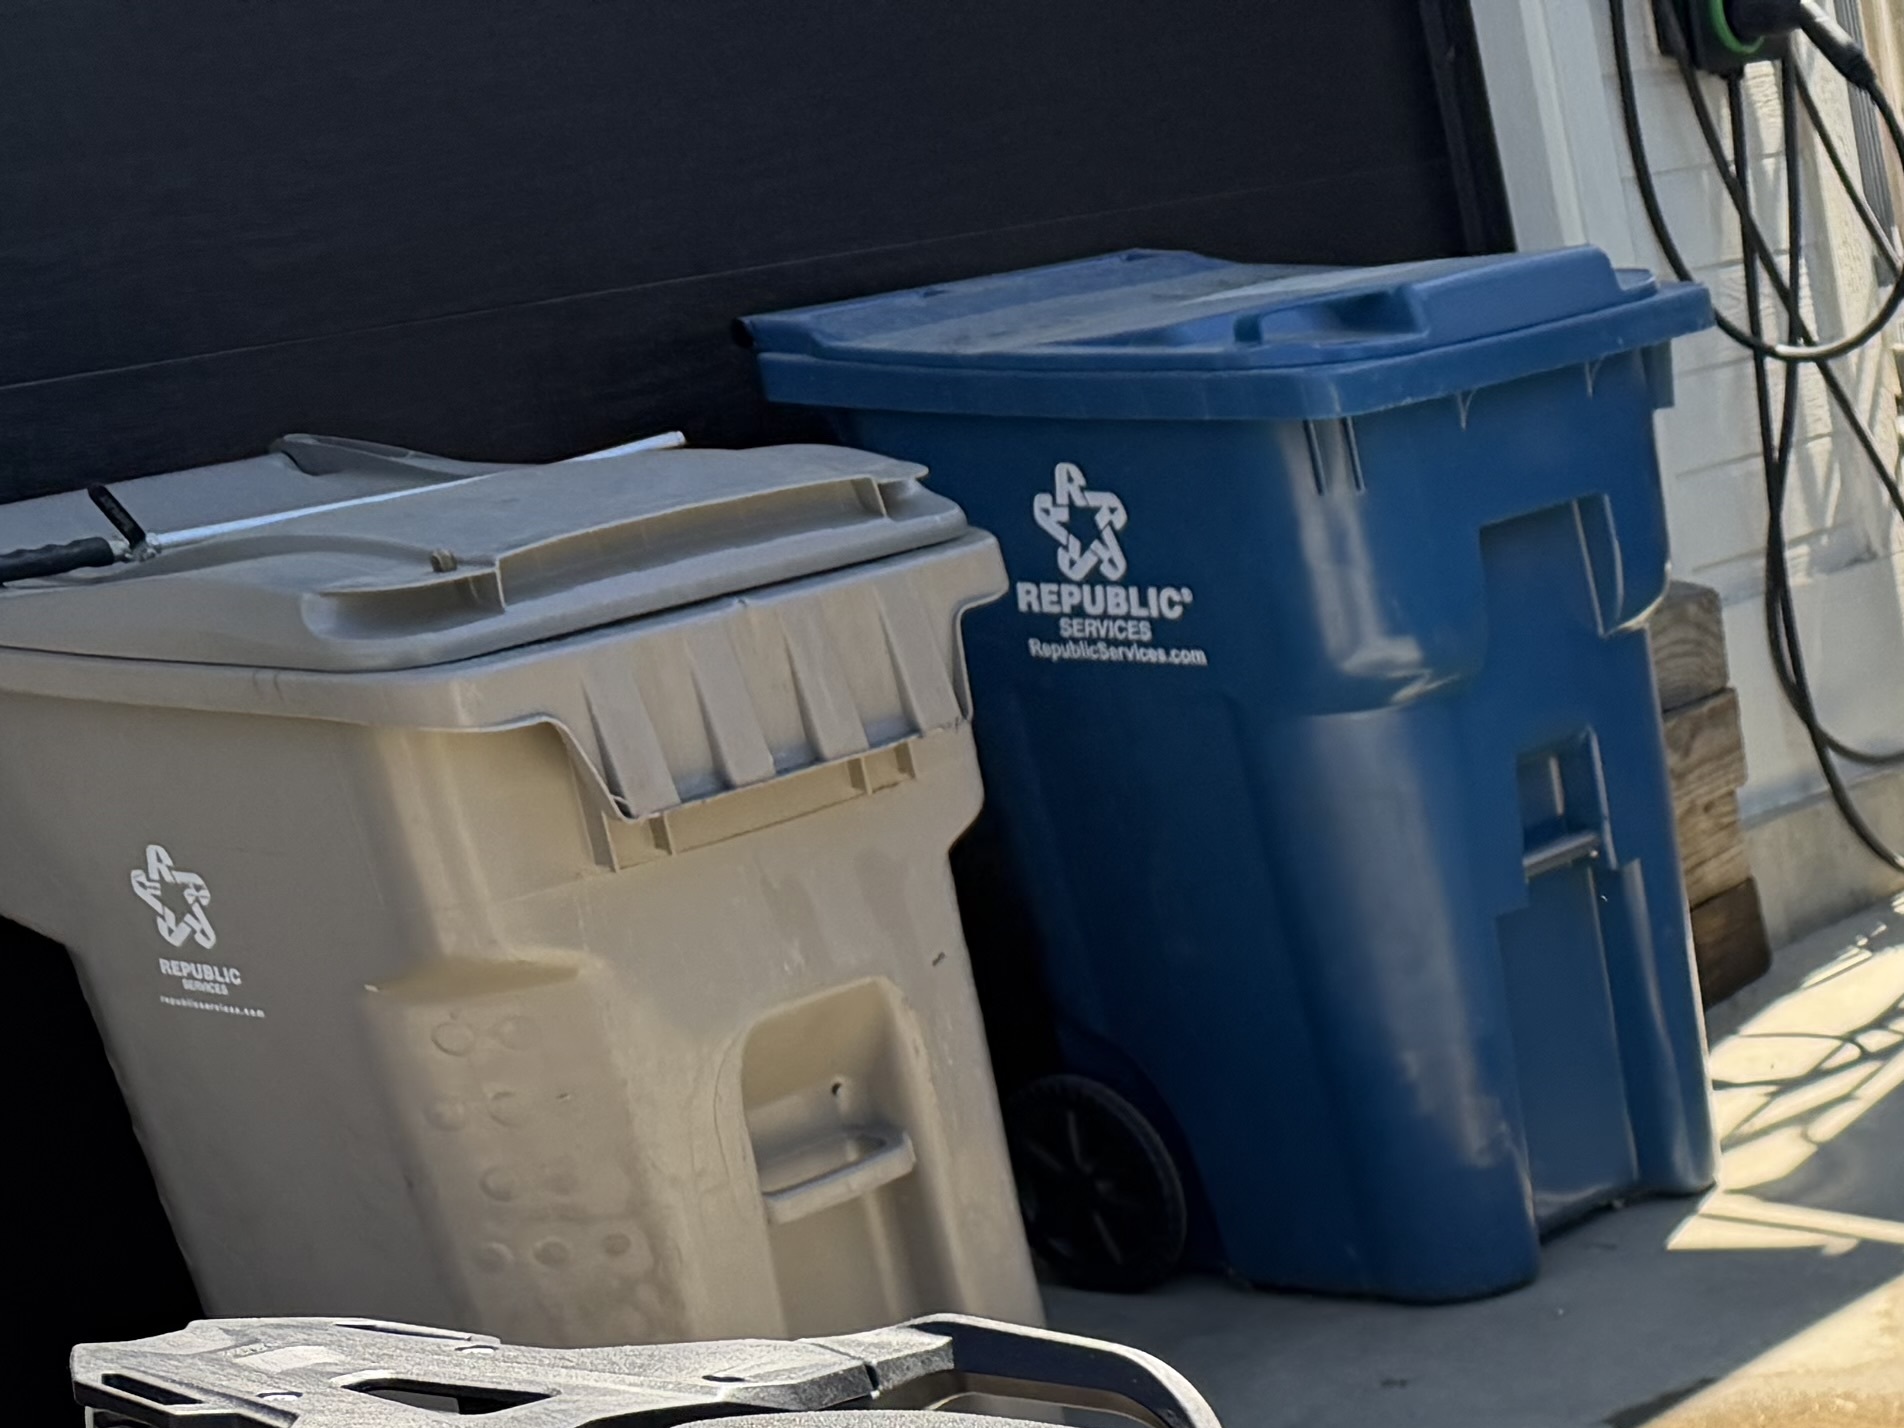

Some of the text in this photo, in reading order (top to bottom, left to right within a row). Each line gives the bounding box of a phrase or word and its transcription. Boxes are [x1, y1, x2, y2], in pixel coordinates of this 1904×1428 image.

[1059, 617, 1153, 641] SERVICES
[1028, 638, 1208, 666] RepublicServices.com
[158, 957, 242, 985] REPUBLIC
[181, 977, 229, 996] SERVICES
